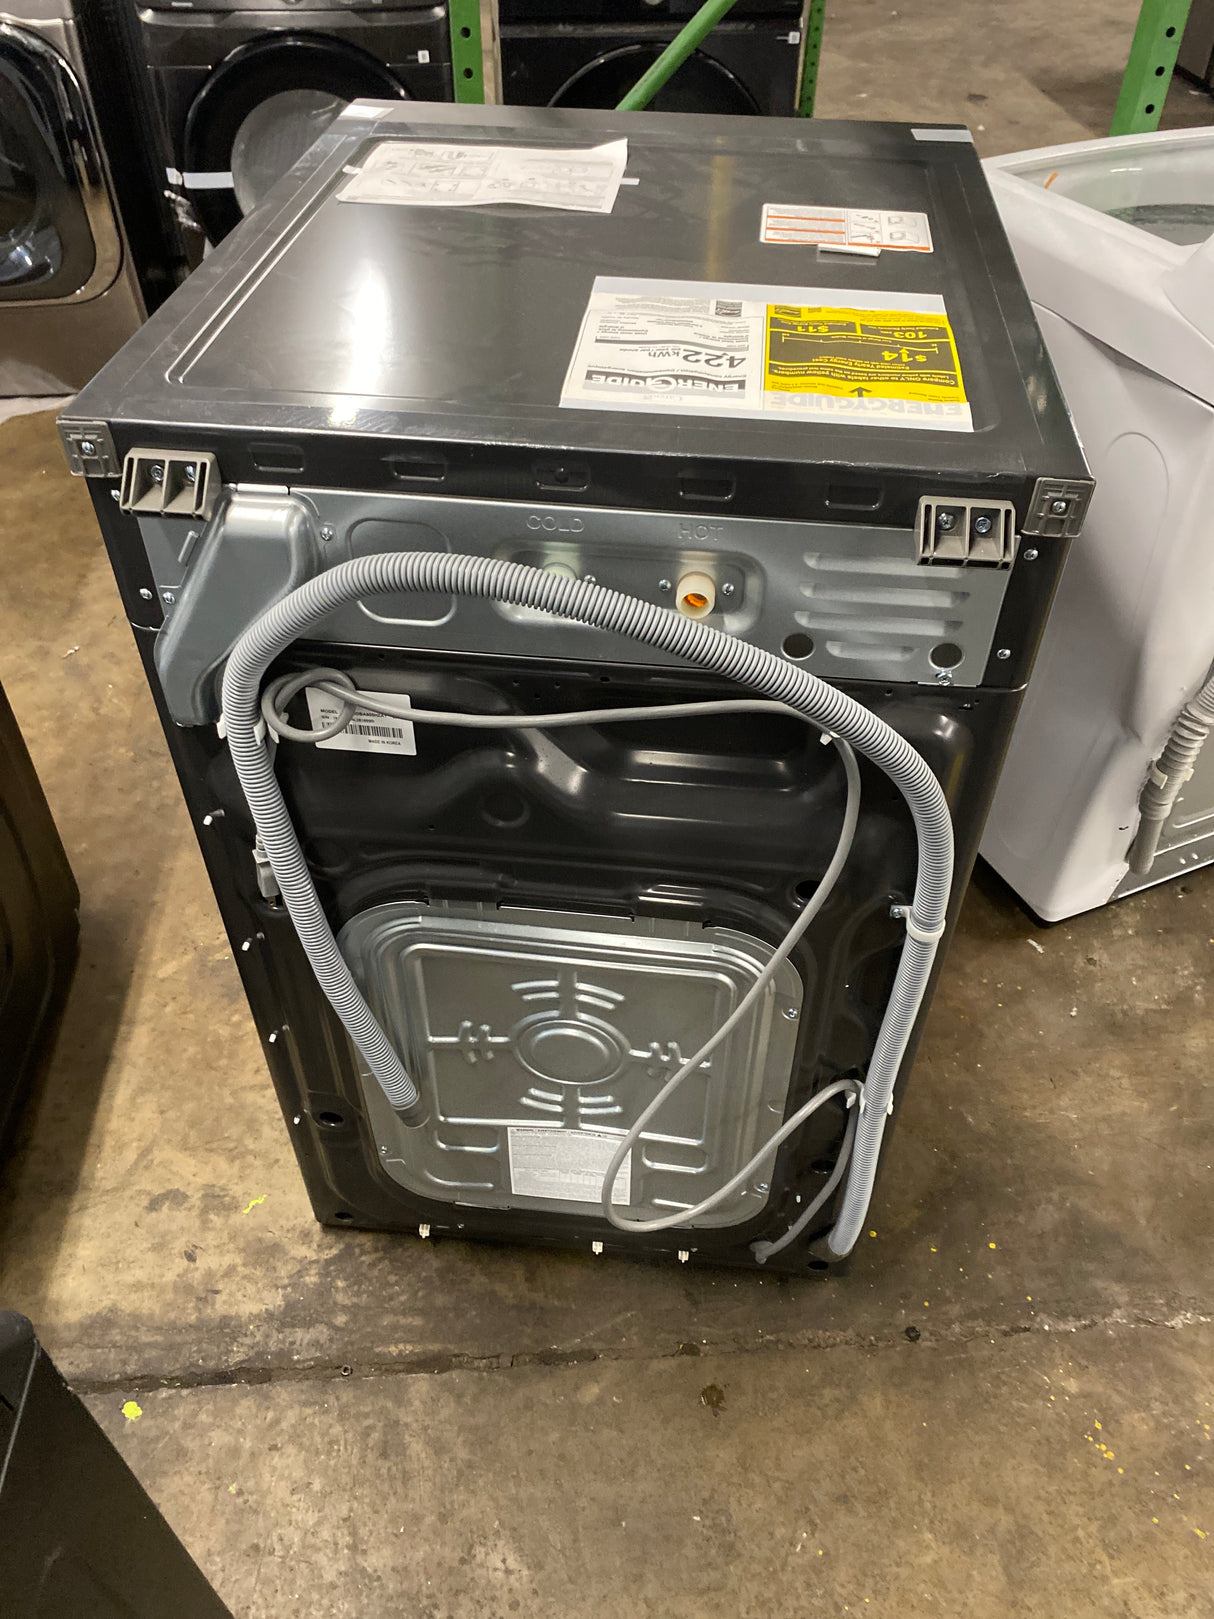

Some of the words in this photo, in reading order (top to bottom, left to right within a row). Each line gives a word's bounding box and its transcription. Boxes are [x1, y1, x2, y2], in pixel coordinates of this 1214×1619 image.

[797, 325, 829, 333] $11
[893, 331, 928, 339] 103
[649, 351, 680, 359] kWh
[682, 349, 747, 369] 422
[882, 351, 928, 363] $14
[854, 361, 875, 369] Yearly
[591, 375, 739, 392] ENERGUIDE
[922, 377, 955, 385] Compare
[771, 392, 962, 416] ENERGYGUIDE
[526, 515, 584, 533] COLD
[678, 523, 724, 541] HOT
